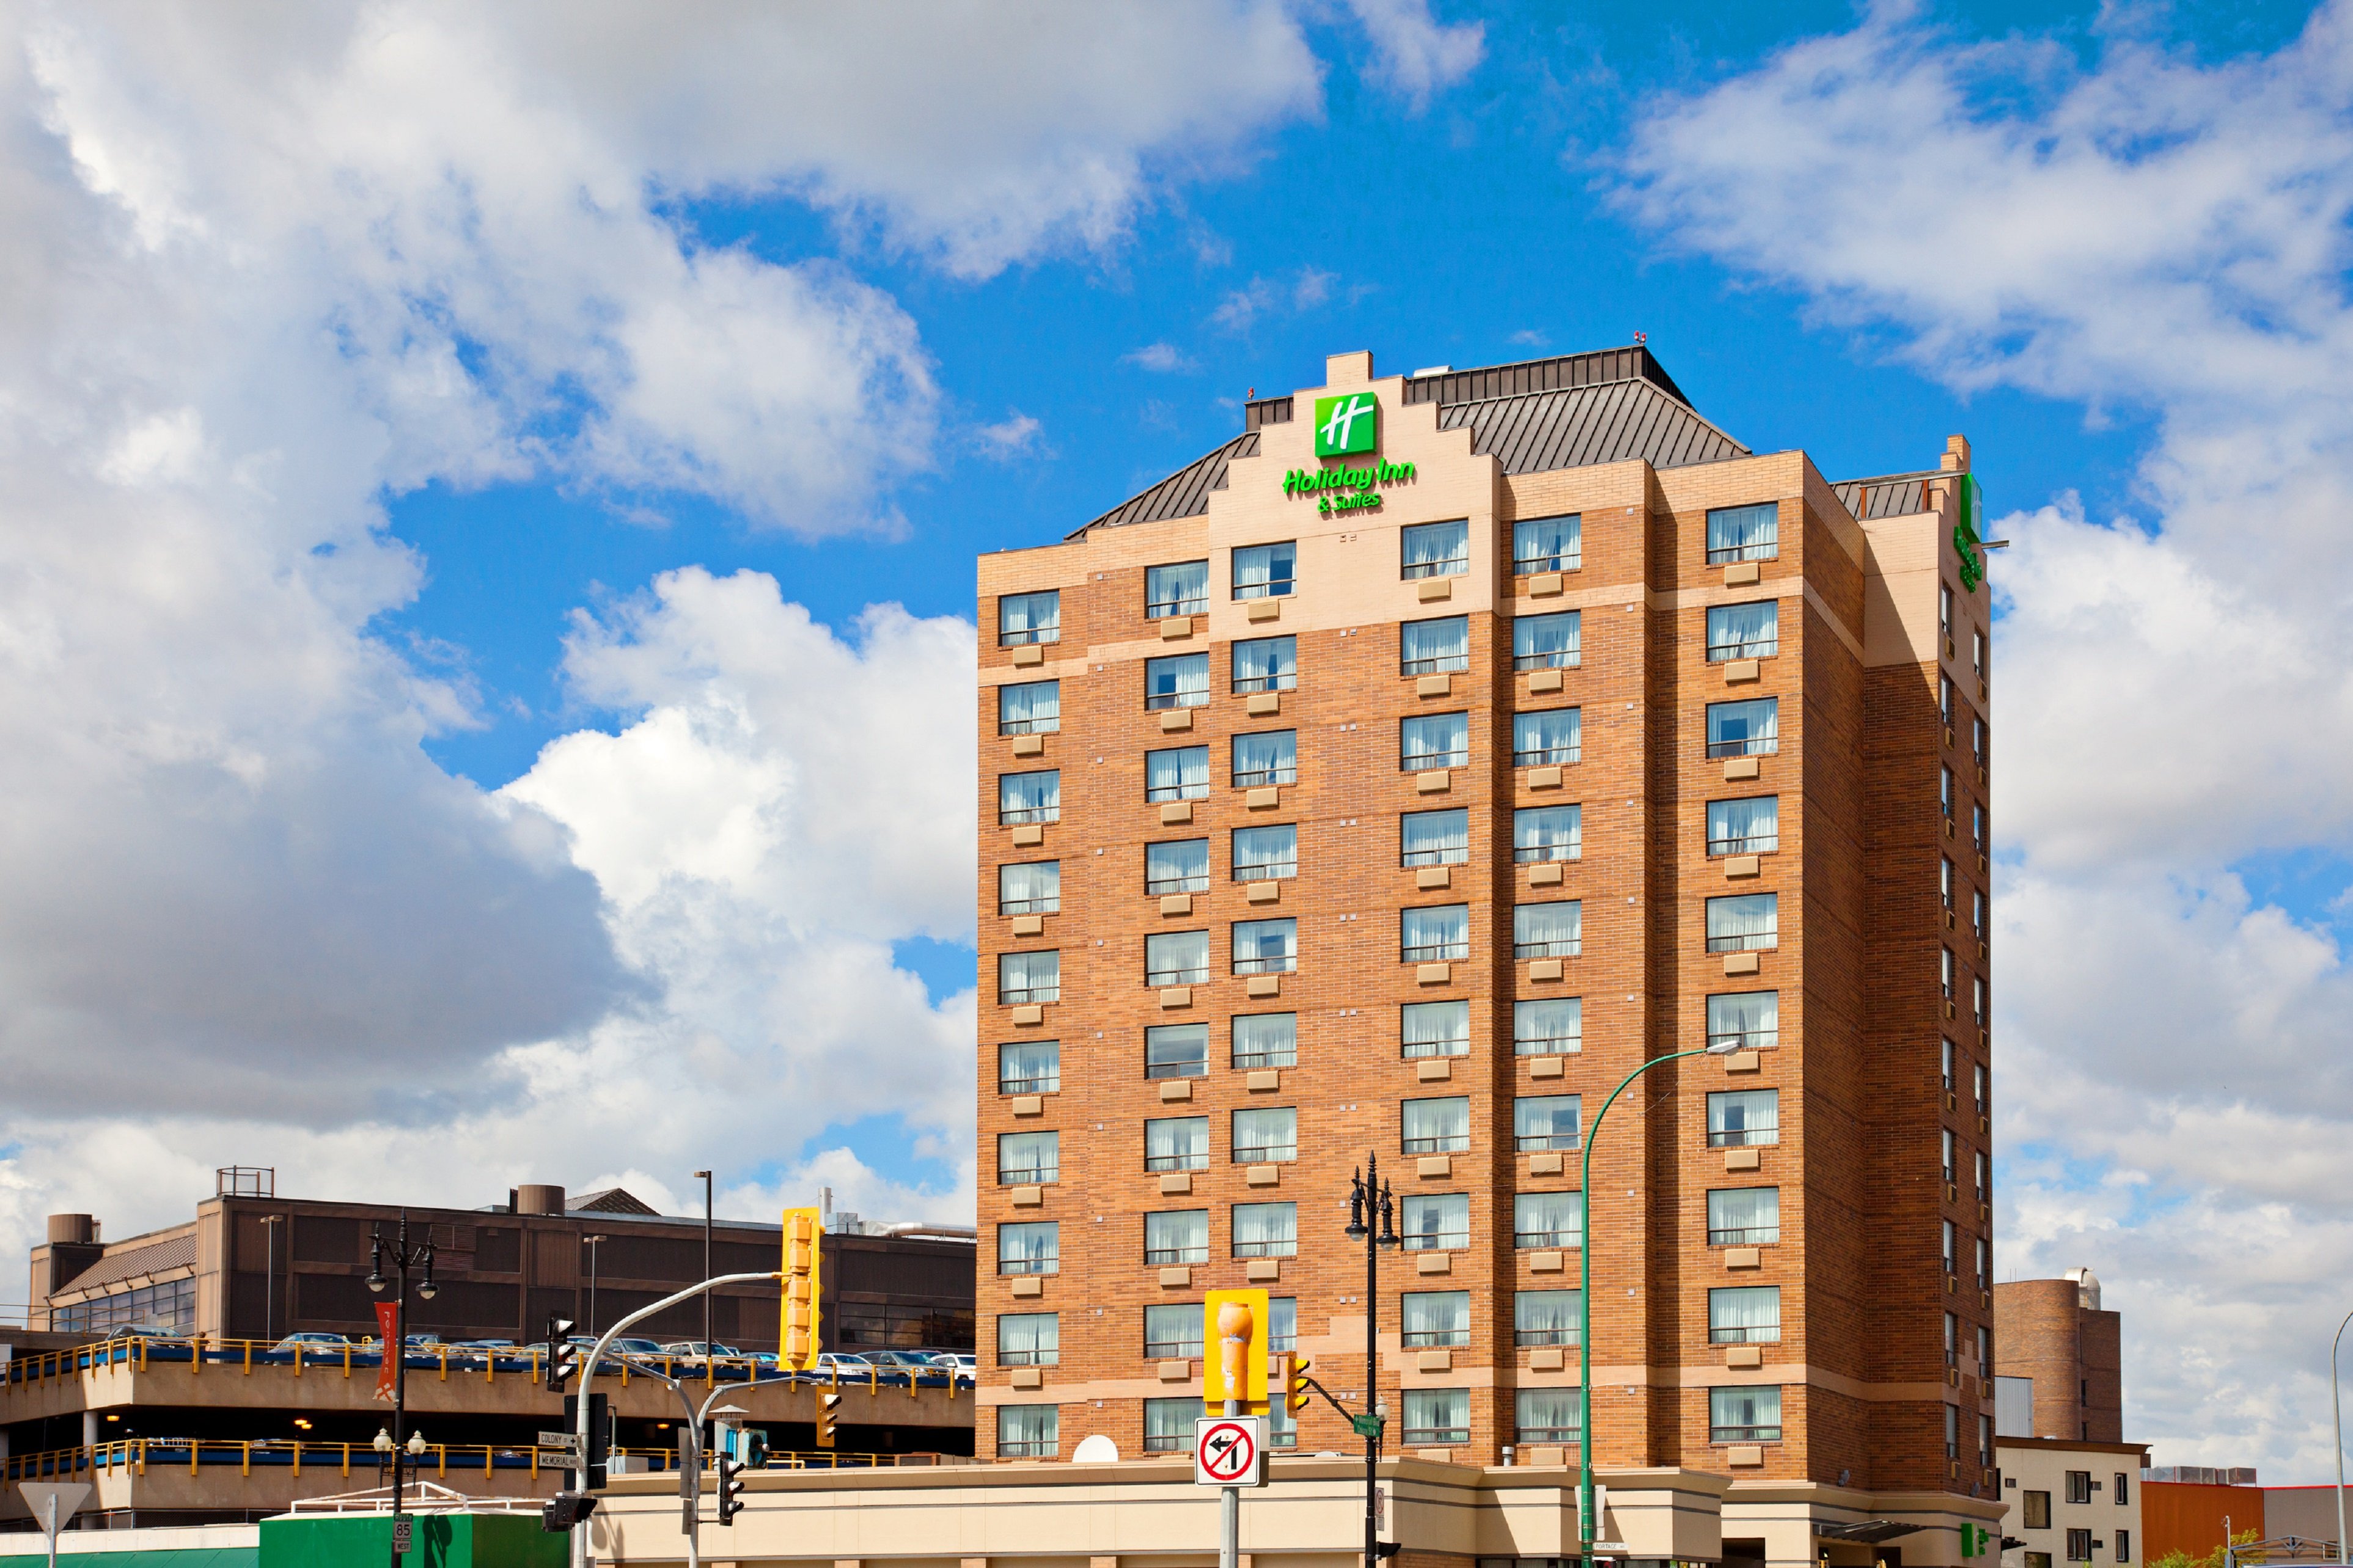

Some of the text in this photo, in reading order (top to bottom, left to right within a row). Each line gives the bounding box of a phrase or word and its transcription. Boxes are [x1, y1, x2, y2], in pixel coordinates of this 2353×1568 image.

[1282, 457, 1415, 494] Holiday Inn
[1317, 491, 1380, 512] & Suites
[541, 1434, 562, 1444] COLONY
[542, 1456, 568, 1466] MEMORIAL
[397, 1524, 410, 1536] 85
